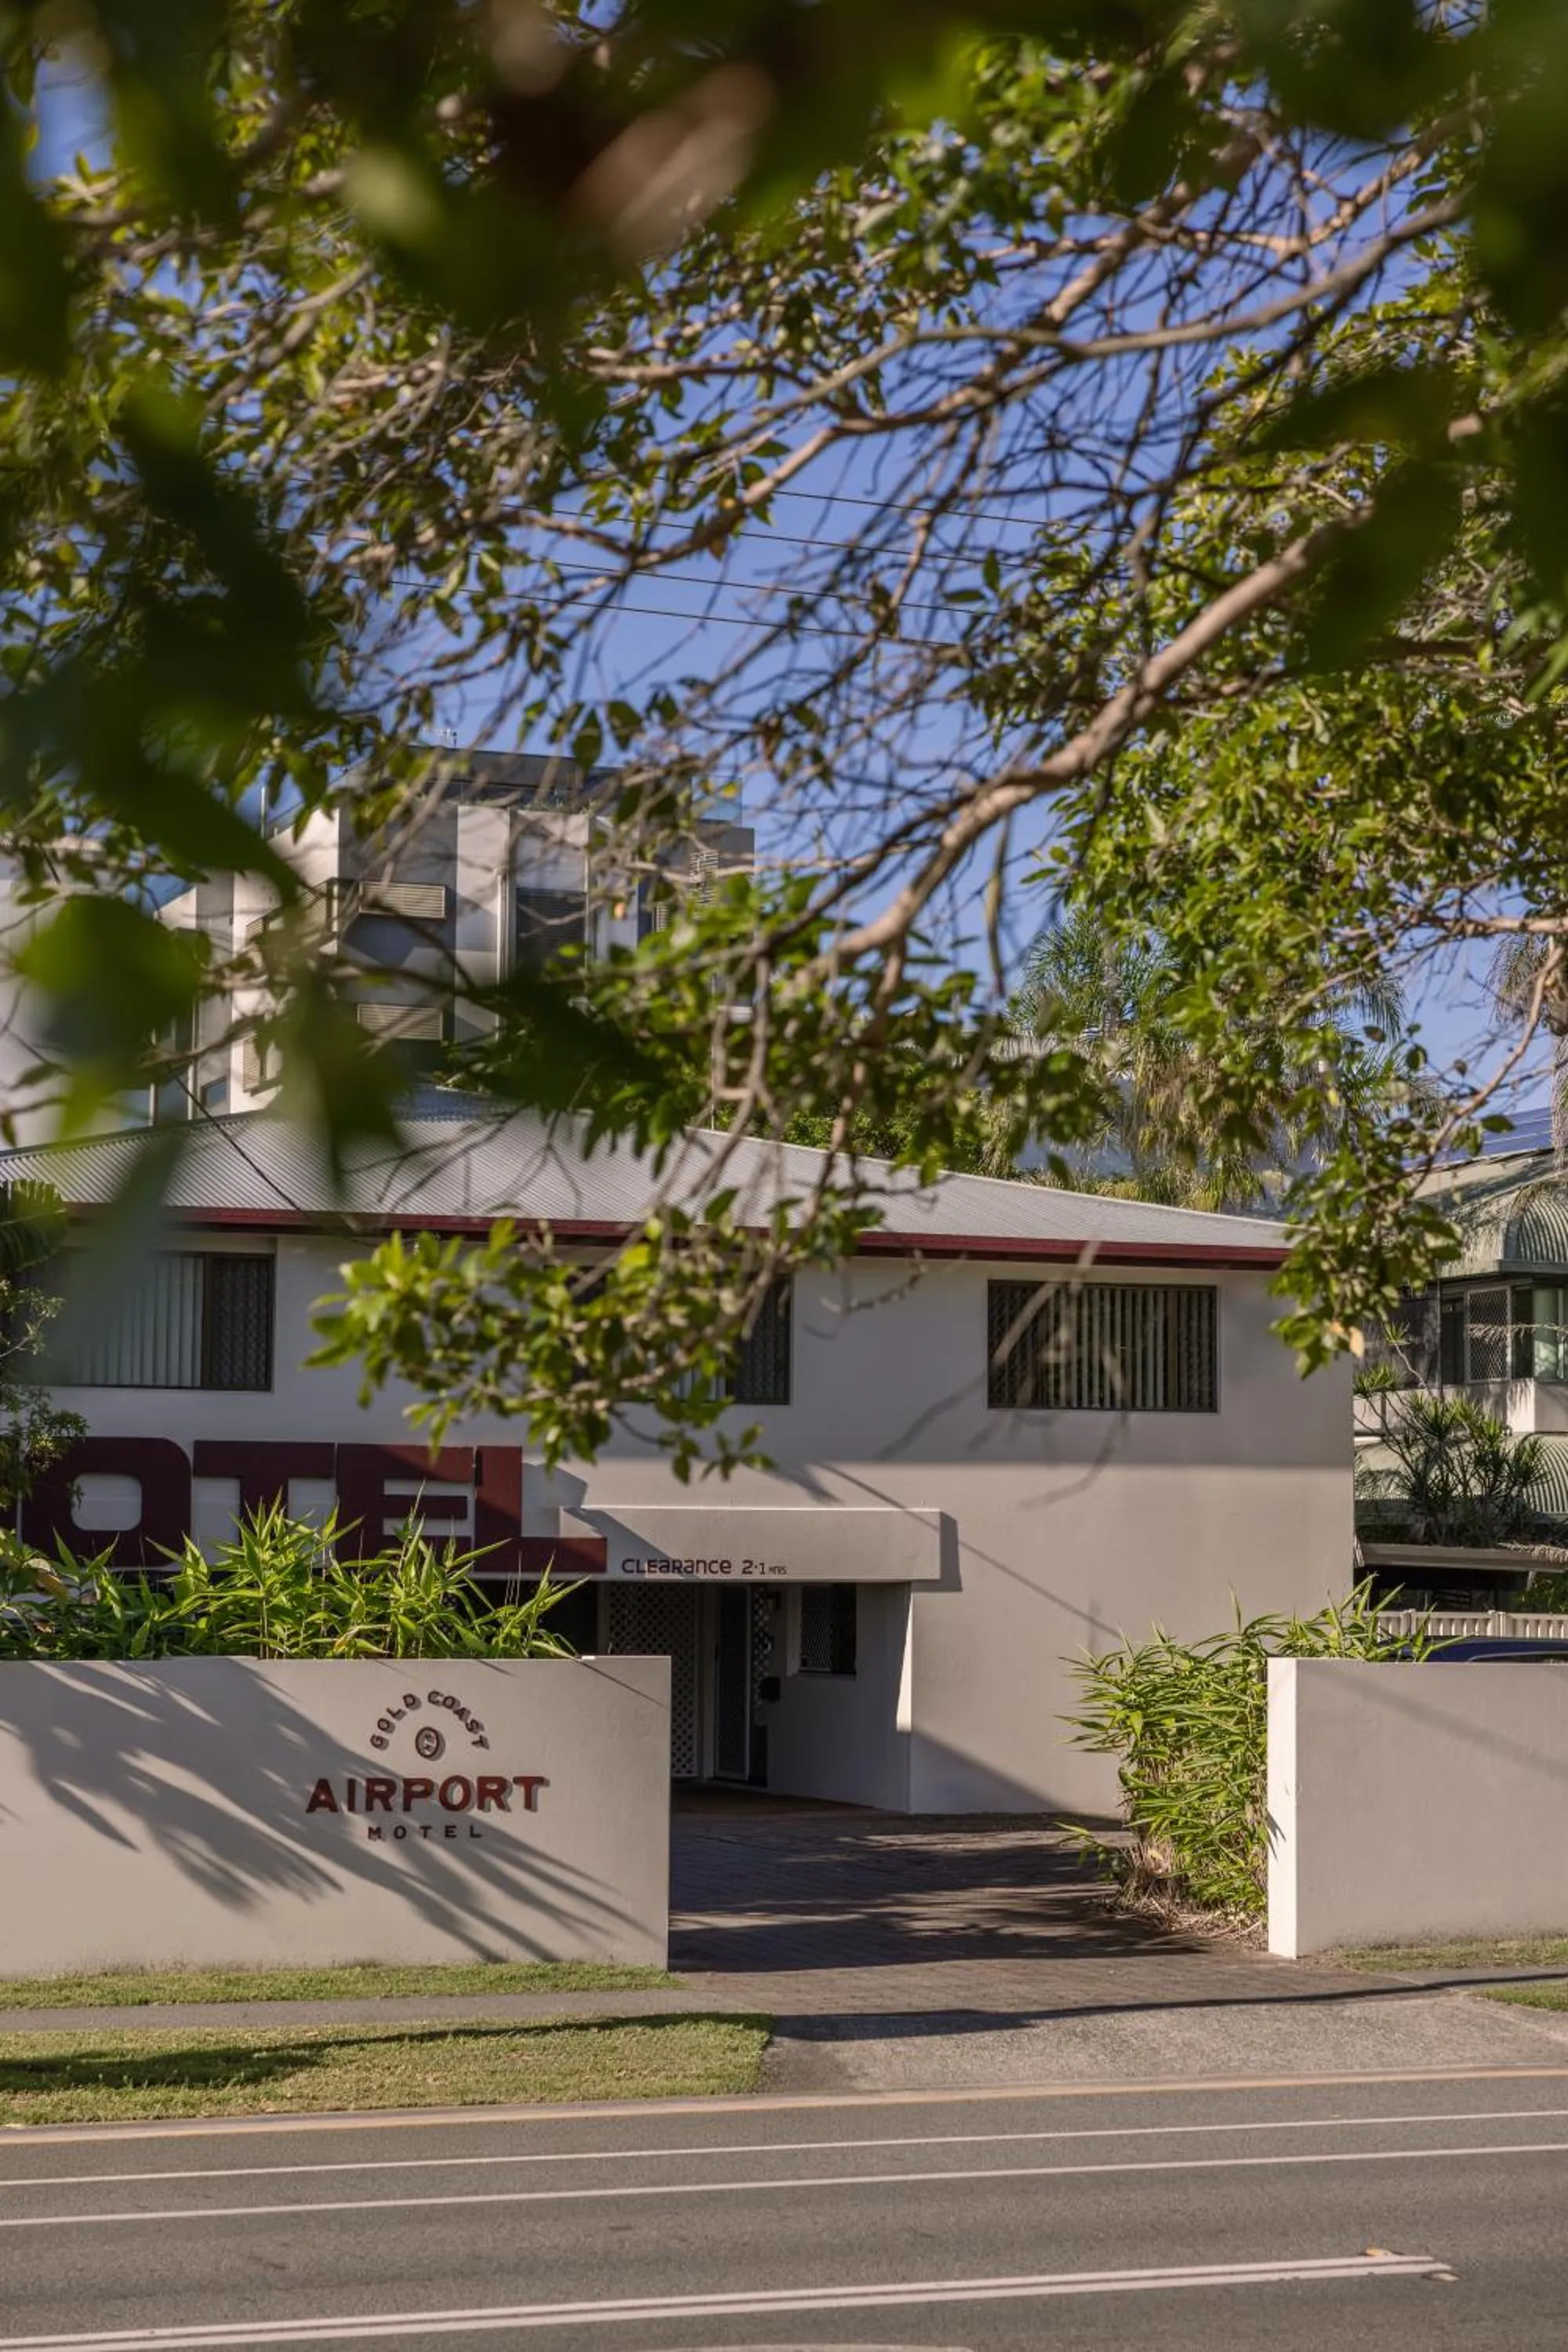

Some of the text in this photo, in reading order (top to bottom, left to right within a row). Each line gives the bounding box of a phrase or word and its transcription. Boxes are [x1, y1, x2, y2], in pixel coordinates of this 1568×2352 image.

[0, 1436, 608, 1573] OTEL
[369, 1690, 486, 1748] GOLD COAST
[306, 1775, 546, 1813] AIRPORT
[367, 1824, 484, 1840] MOTEL
